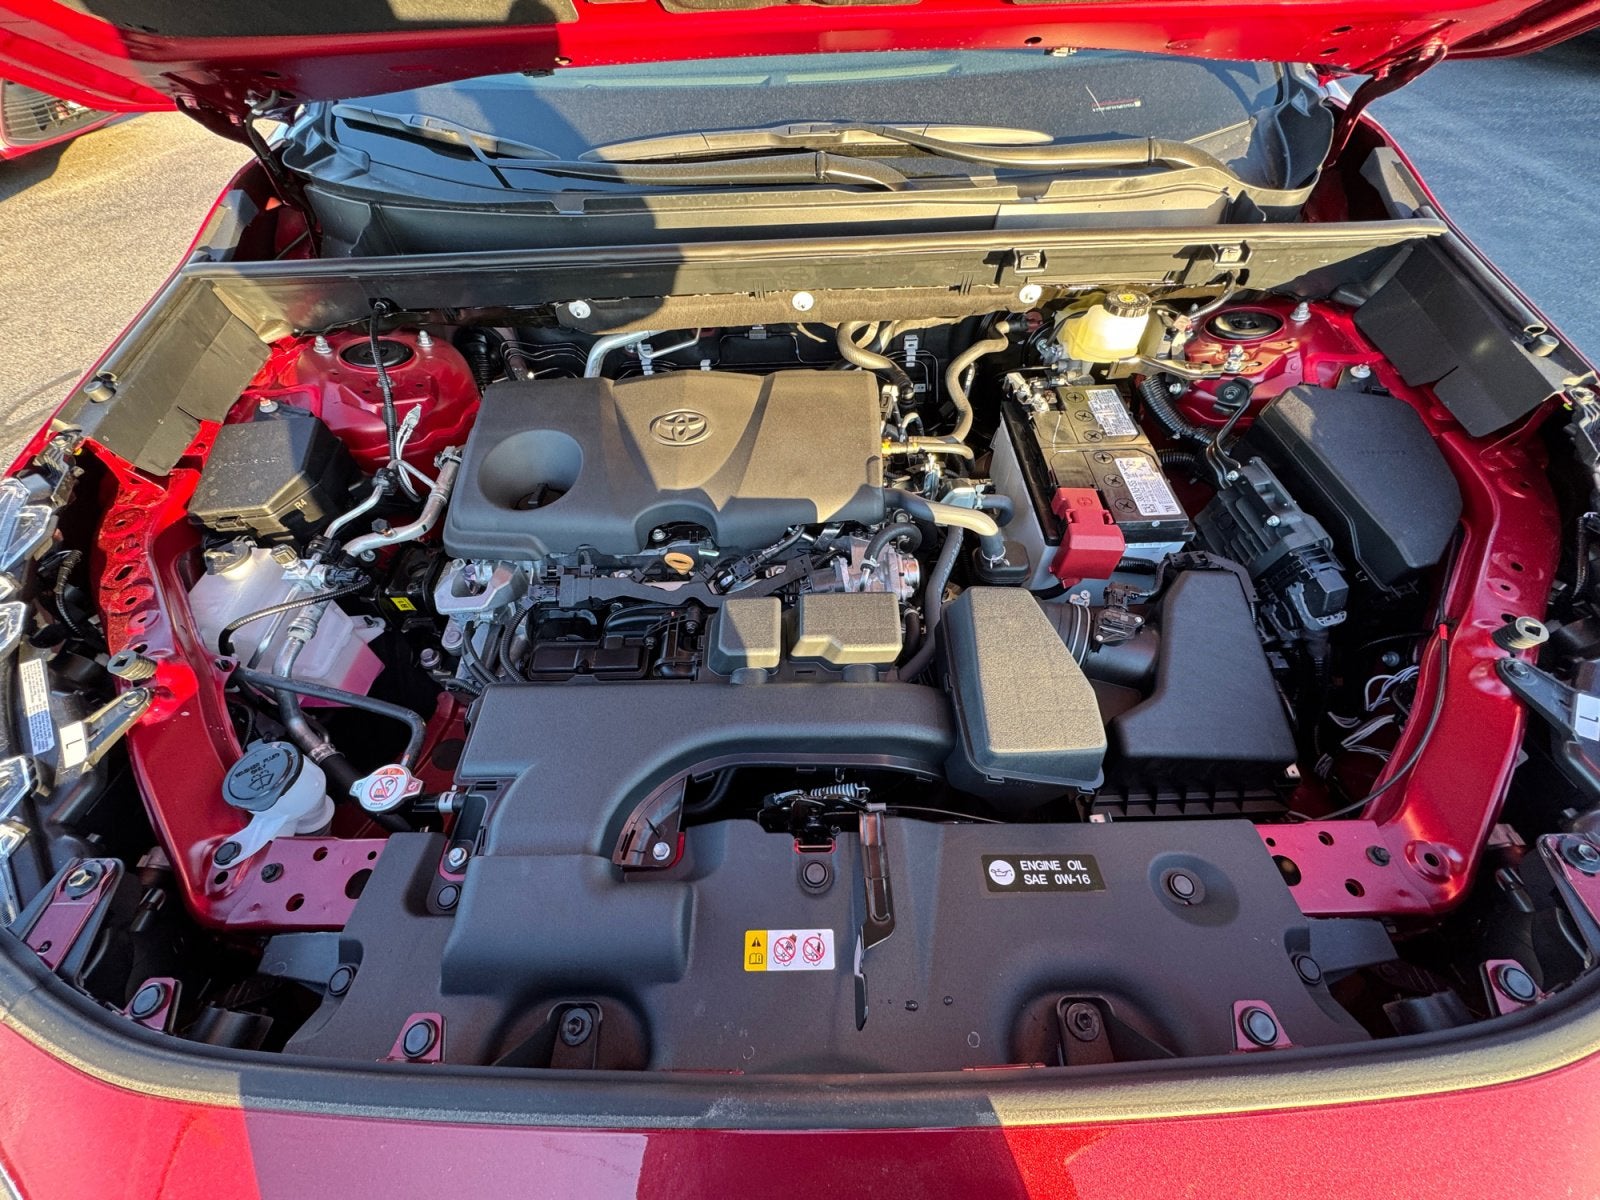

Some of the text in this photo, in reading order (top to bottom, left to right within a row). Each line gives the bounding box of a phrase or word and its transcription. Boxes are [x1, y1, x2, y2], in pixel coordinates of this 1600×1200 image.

[1020, 860, 1088, 871] ENGINE OIL
[1024, 873, 1092, 885] SAE 0W-16
